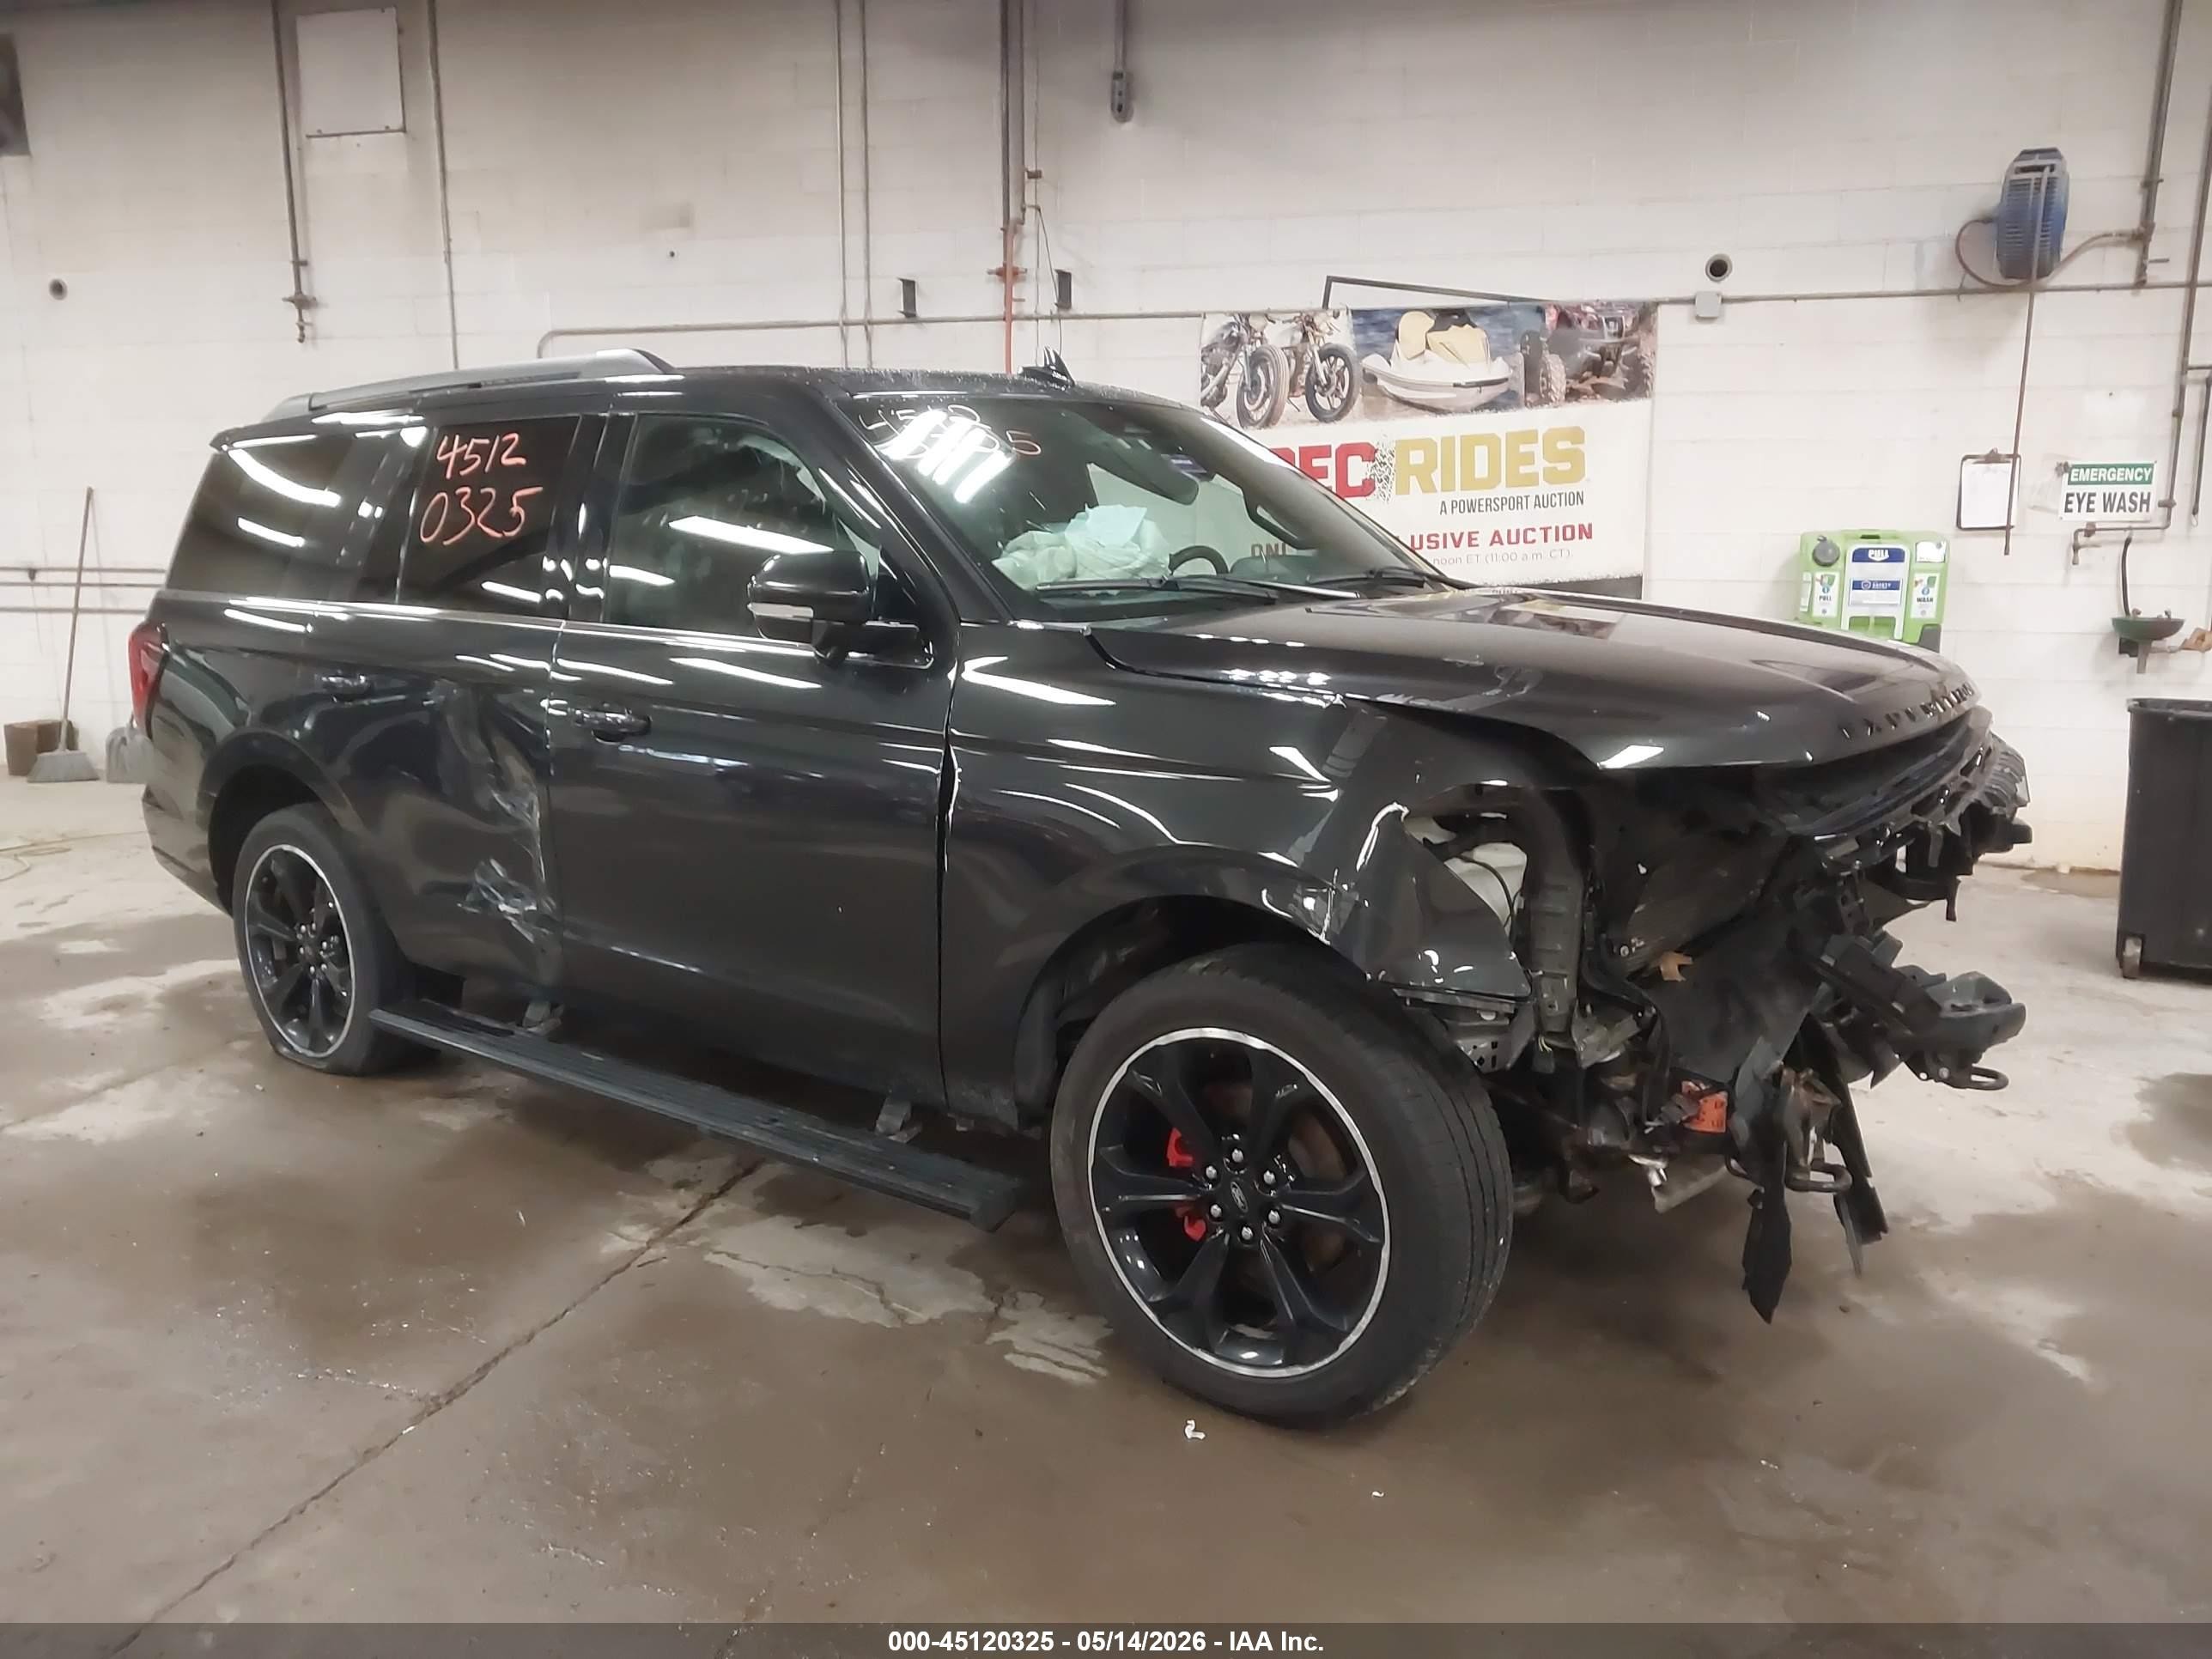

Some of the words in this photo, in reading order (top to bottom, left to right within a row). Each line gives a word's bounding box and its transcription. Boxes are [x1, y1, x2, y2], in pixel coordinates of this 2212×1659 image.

[436, 432, 526, 479] 4512
[1395, 426, 1587, 495] RIDES
[2070, 466, 2153, 482] EMERGENCY
[420, 486, 544, 545] 0325
[1439, 501, 1448, 515] A
[1450, 495, 1531, 515] POWERSPORT
[1533, 490, 1585, 510] AUCTION
[2063, 491, 2097, 514] EYE
[2102, 490, 2152, 514] WASH
[1396, 531, 1480, 552] USIVE
[1489, 522, 1594, 548] AUCTION
[1466, 553, 1481, 565] ET
